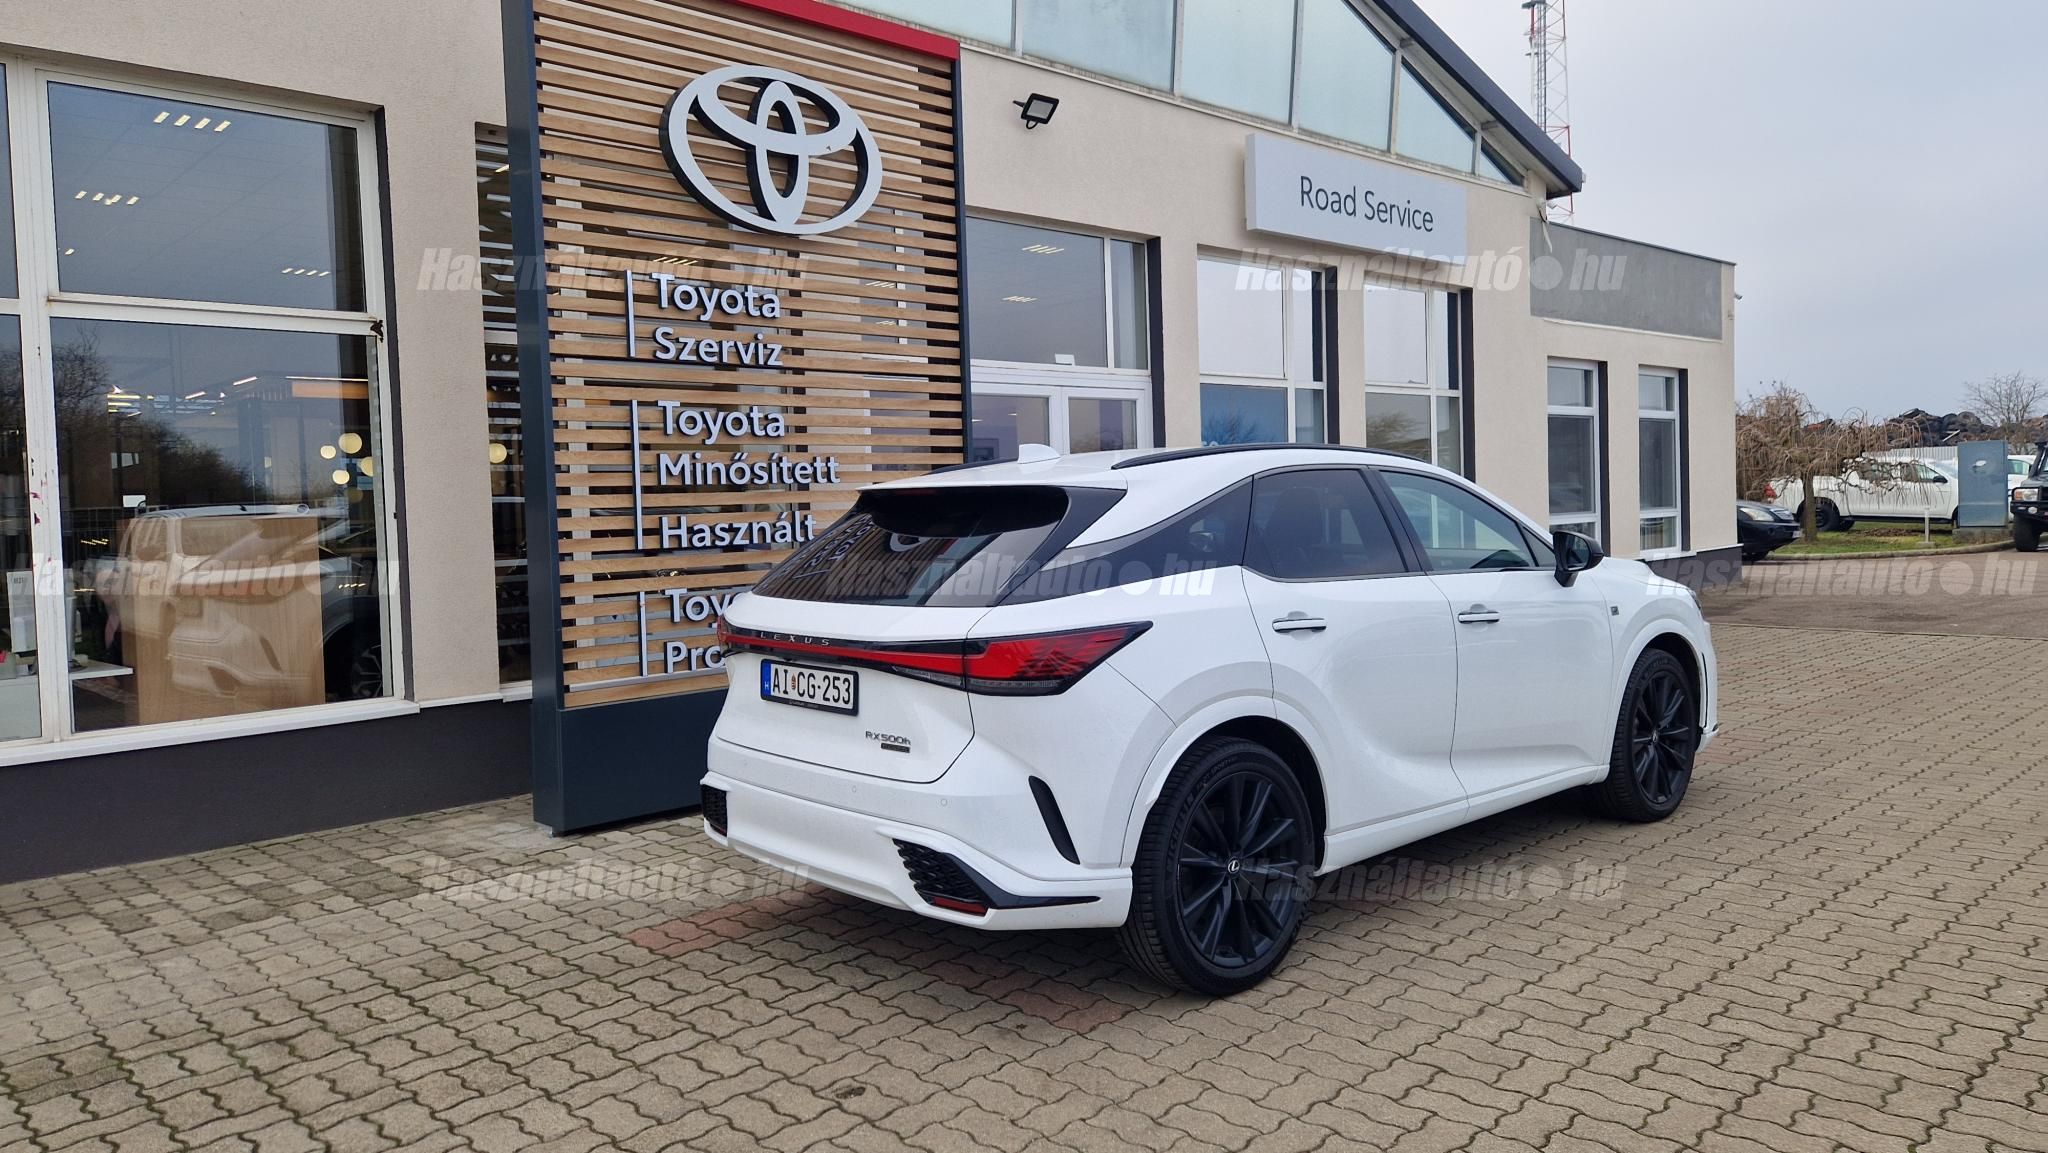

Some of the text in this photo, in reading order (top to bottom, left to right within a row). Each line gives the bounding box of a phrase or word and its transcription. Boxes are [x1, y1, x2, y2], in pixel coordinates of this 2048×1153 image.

[1300, 175, 1434, 232] Road Service
[651, 272, 781, 321] Toyota
[653, 326, 783, 366] Szerviz
[657, 400, 785, 445] Toyota
[659, 452, 841, 486] Minősített
[660, 511, 817, 549] Használt
[665, 588, 731, 629] Toy
[664, 641, 726, 674] Pro
[760, 631, 831, 646] LEXUS
